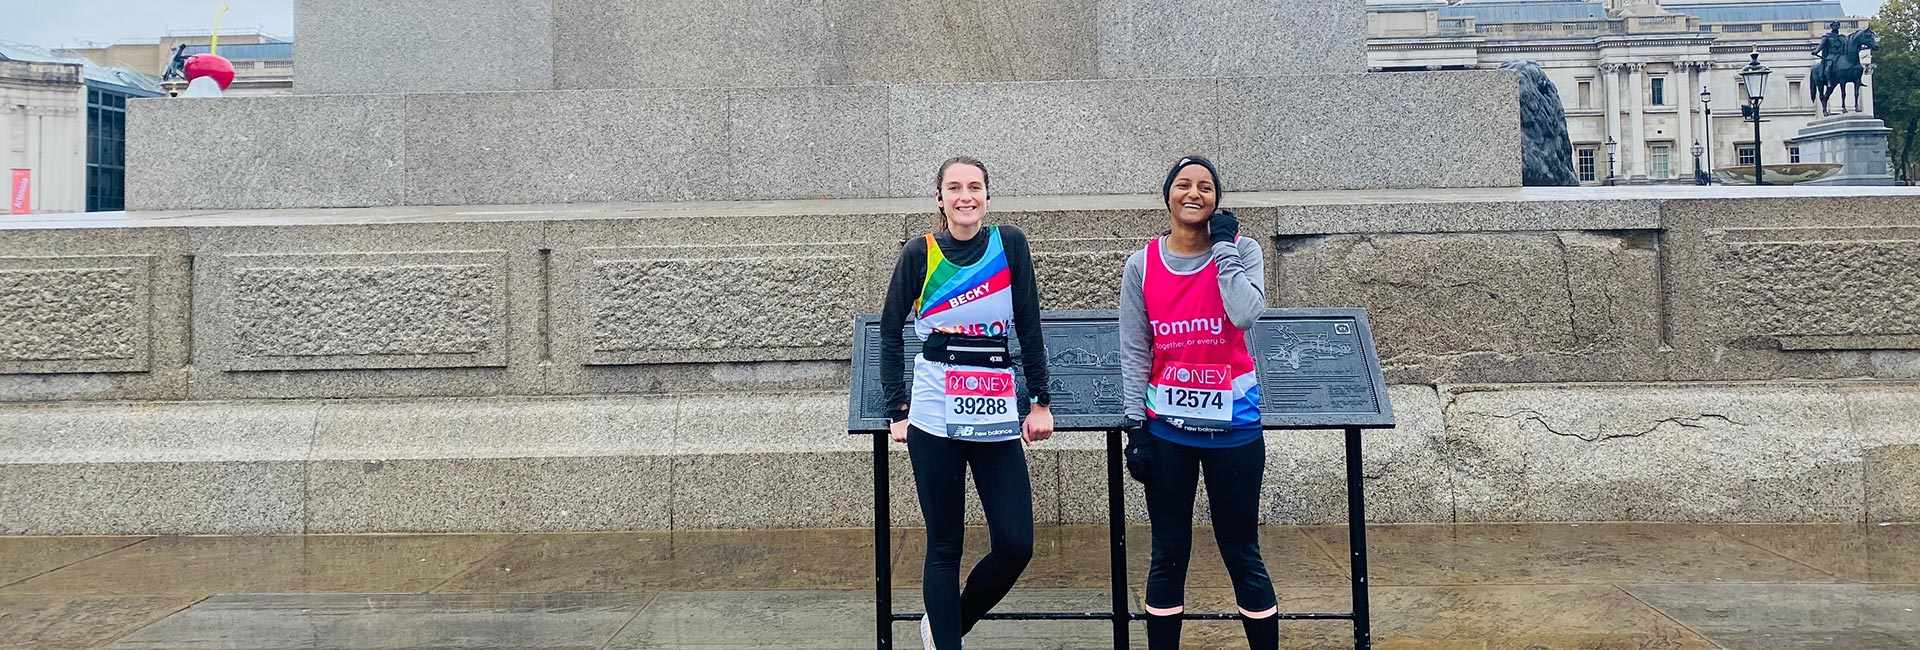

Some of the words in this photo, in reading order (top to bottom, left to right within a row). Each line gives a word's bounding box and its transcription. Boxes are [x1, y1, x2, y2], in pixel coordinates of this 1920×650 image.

[949, 282, 990, 308] BECKY
[1150, 314, 1227, 336] Tommy'
[949, 375, 1009, 392] MONEY
[1163, 366, 1227, 384] MONEY
[953, 397, 1008, 415] 39288
[1165, 388, 1223, 409] 12574
